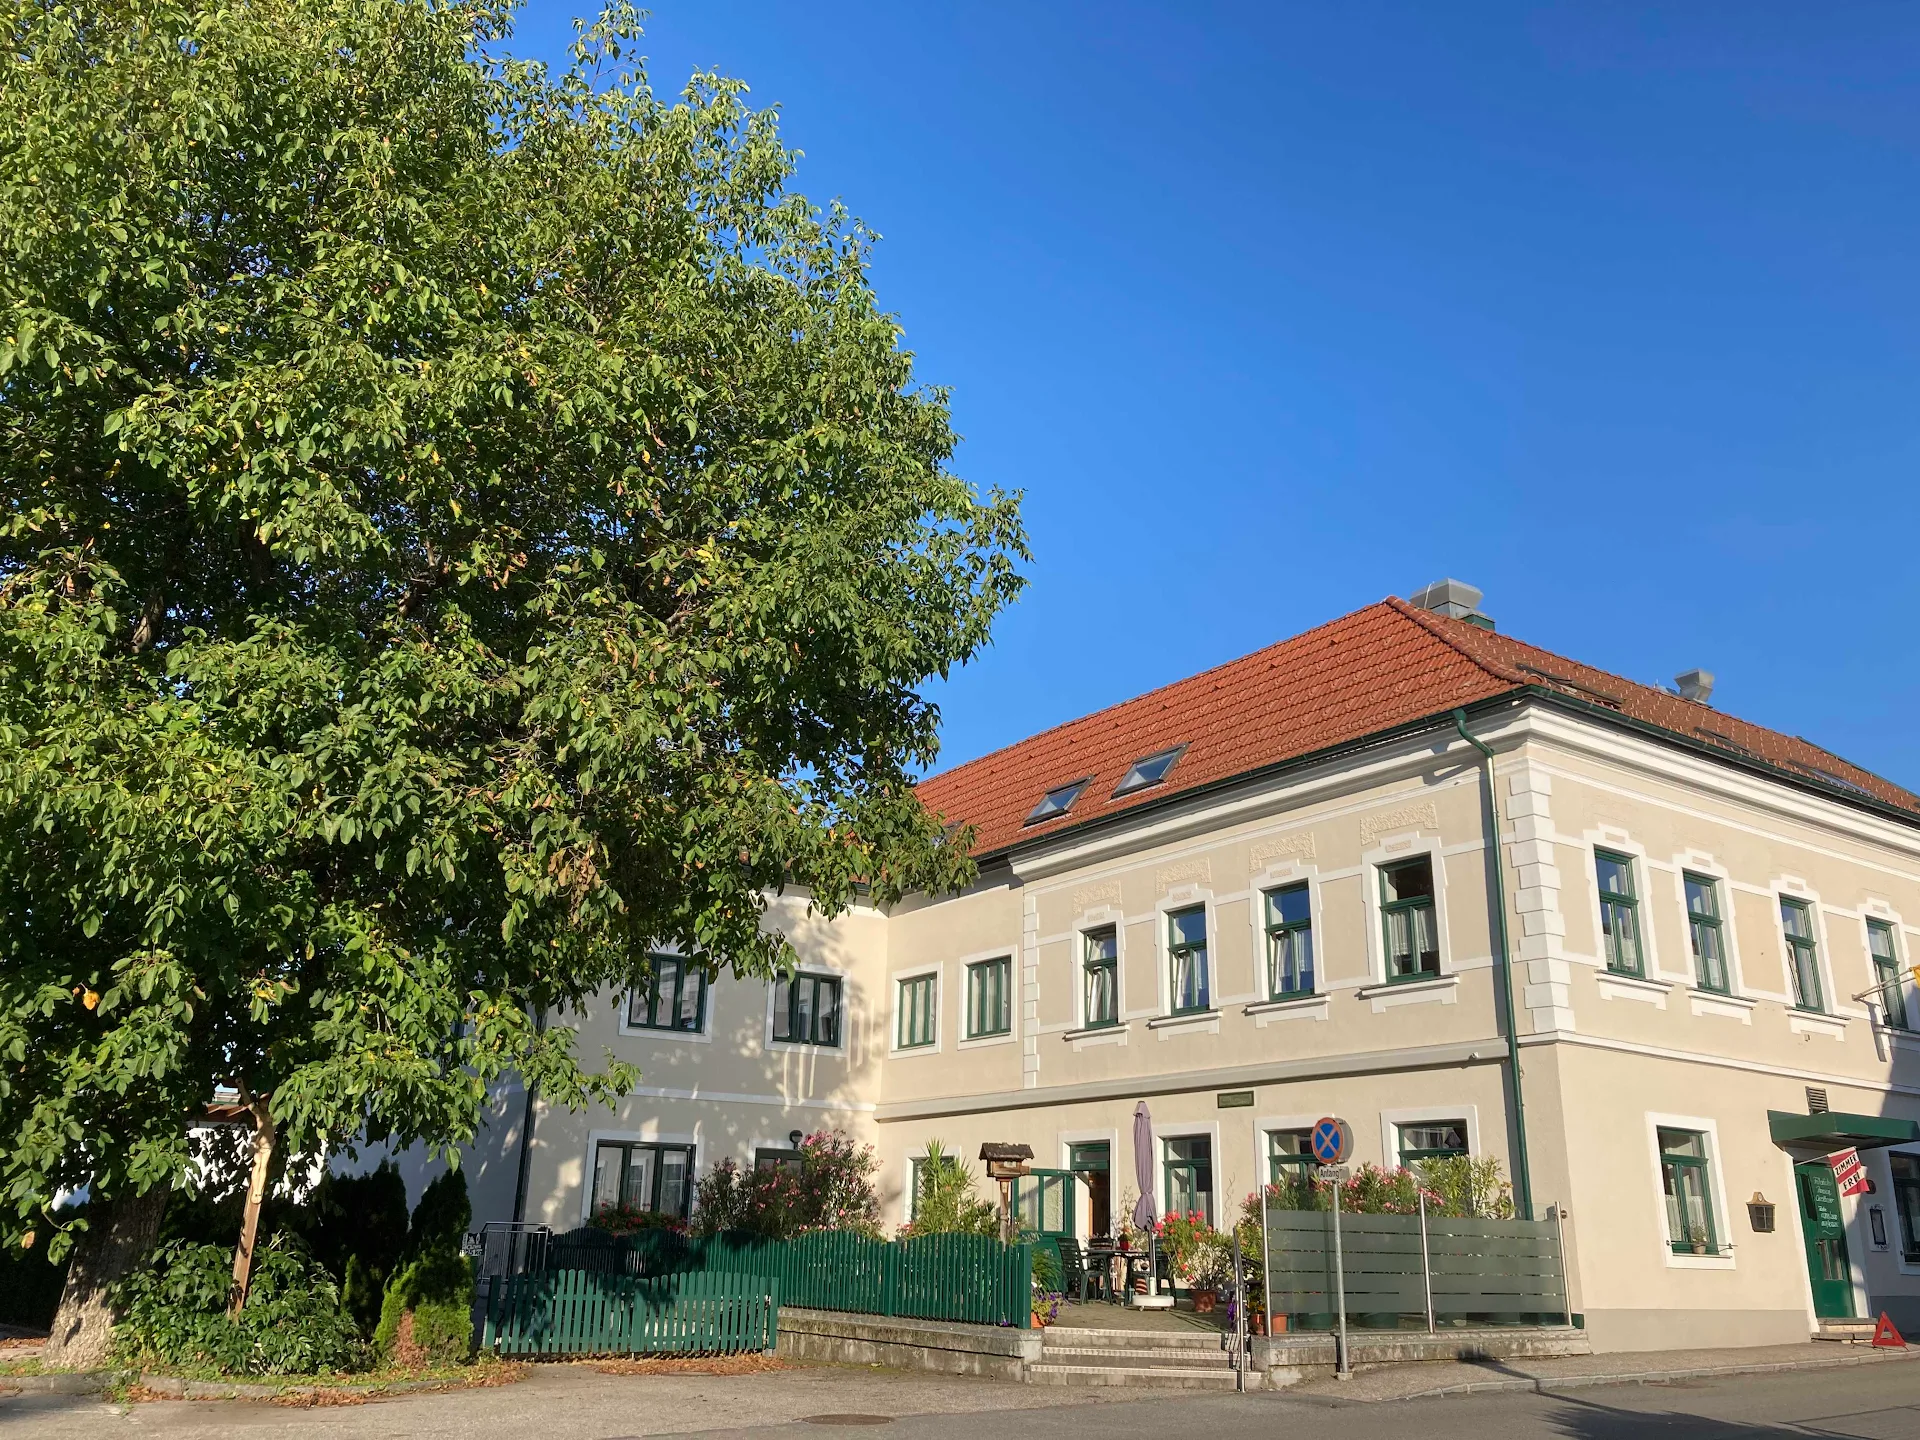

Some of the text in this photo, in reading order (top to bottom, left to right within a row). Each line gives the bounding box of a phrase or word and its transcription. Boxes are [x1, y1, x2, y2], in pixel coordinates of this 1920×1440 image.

[1320, 1169, 1340, 1179] Anfang
[1835, 1154, 1858, 1176] ZIMMER
[1842, 1171, 1861, 1190] FREI
